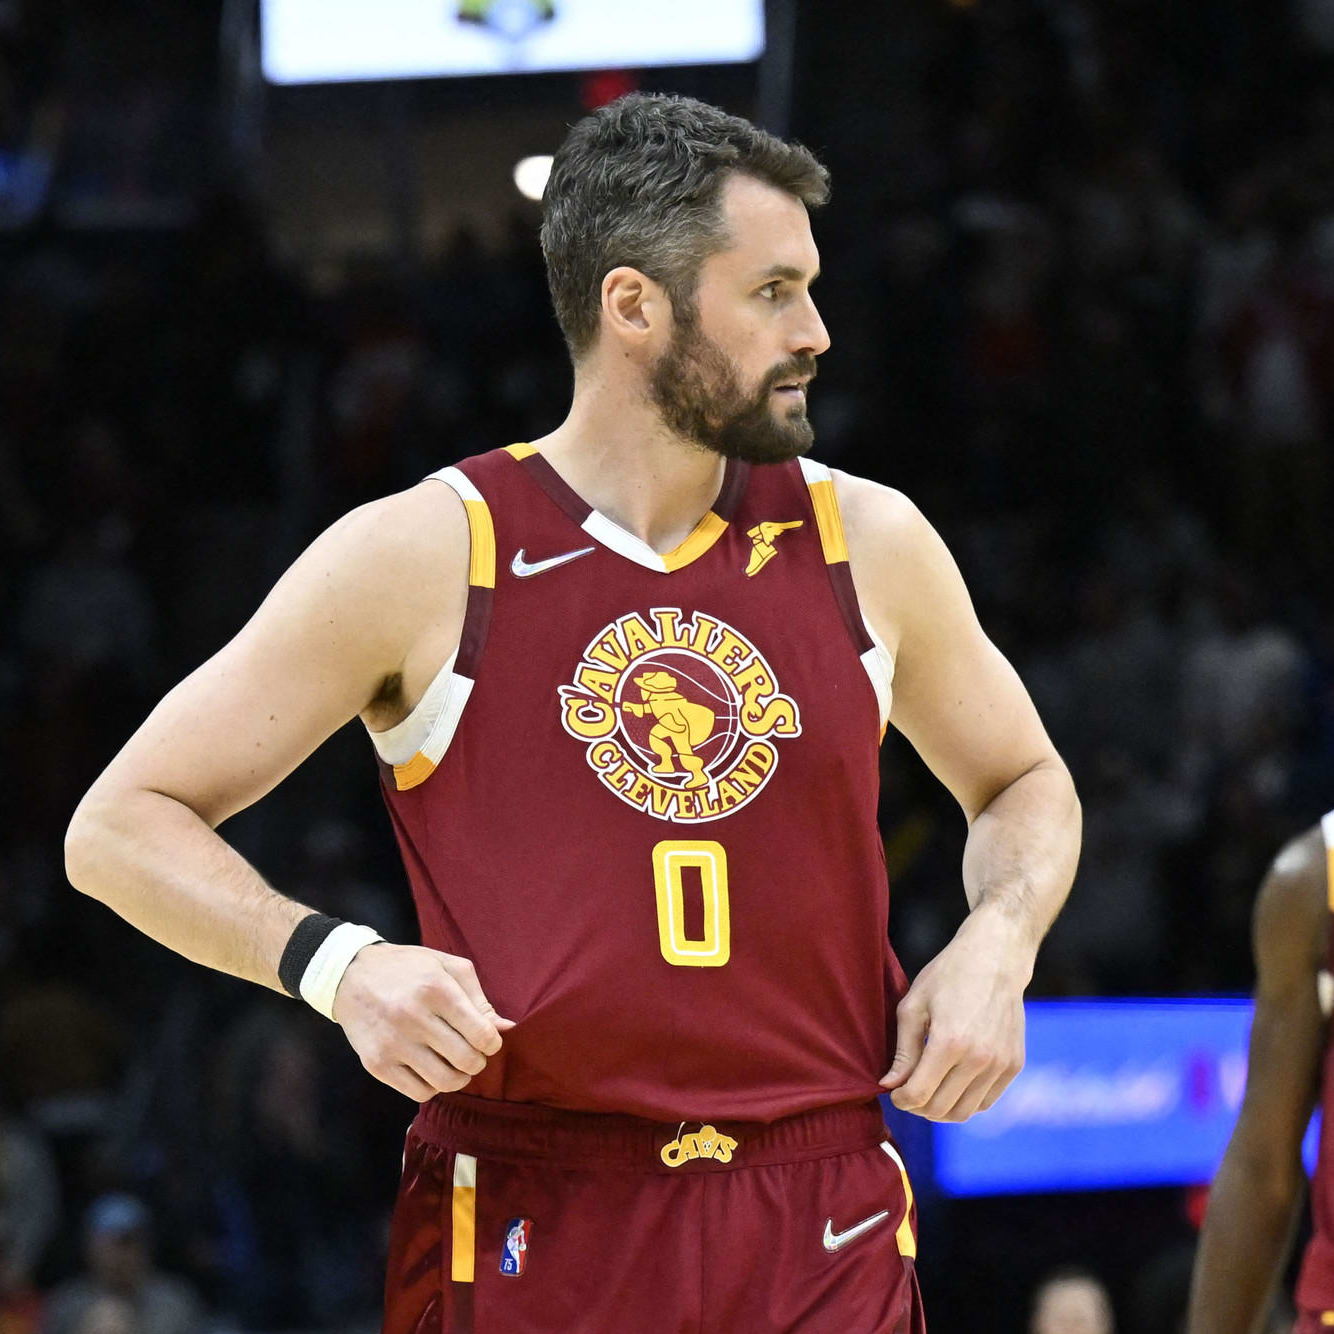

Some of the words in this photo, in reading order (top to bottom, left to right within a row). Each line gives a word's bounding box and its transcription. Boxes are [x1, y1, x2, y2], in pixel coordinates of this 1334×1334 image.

[558, 608, 802, 738] CAVALIERS
[586, 739, 778, 824] CLEVELAND
[652, 840, 730, 967] 0
